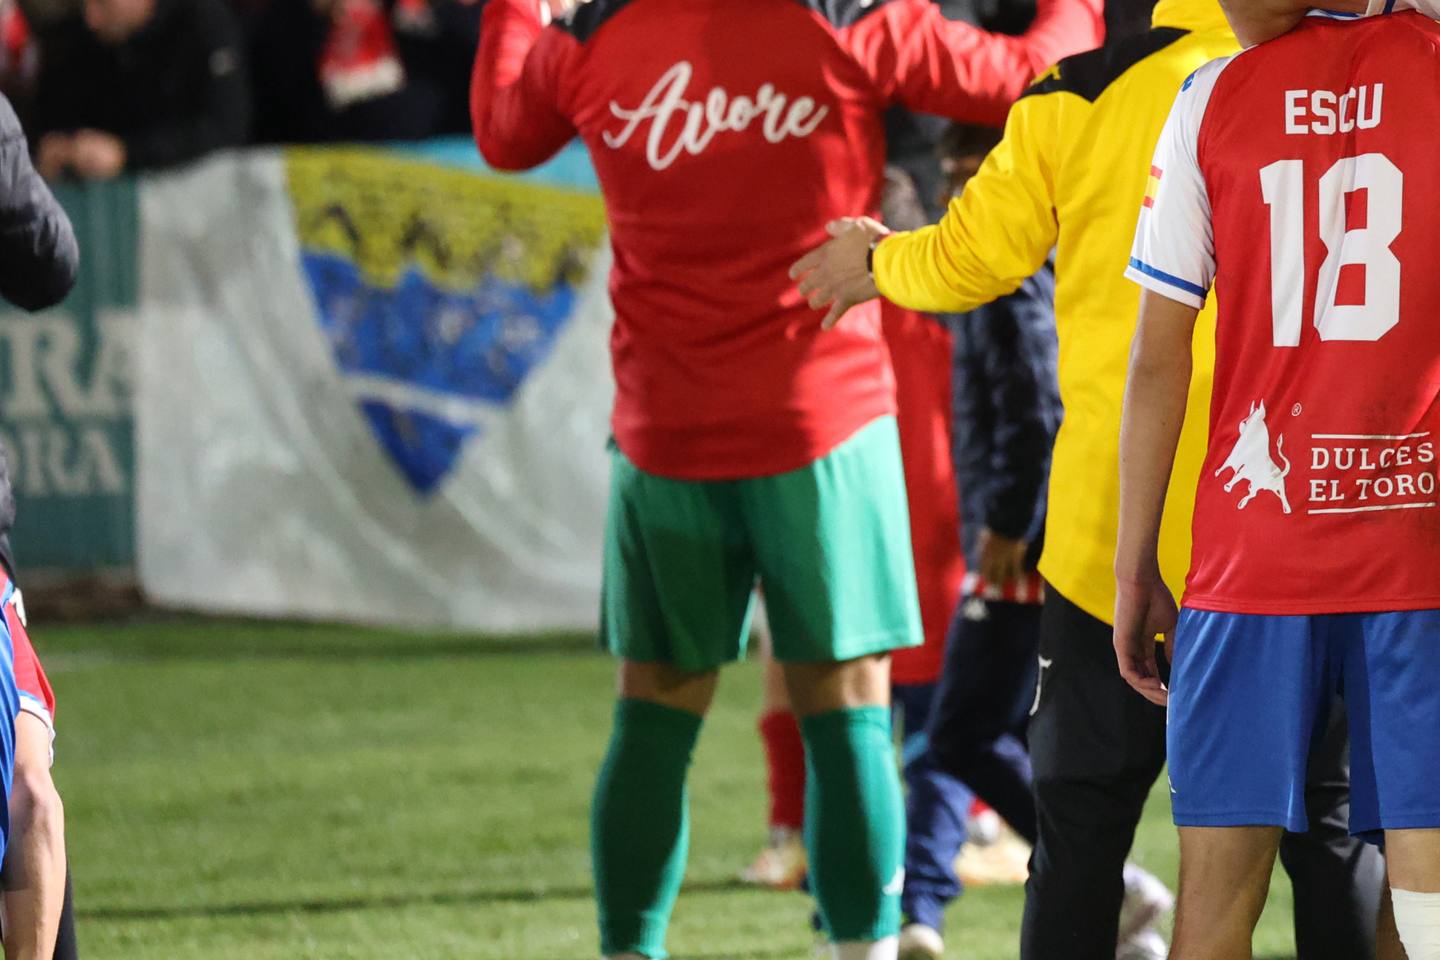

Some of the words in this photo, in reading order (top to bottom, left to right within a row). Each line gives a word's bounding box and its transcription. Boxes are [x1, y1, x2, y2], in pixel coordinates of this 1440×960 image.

[602, 60, 829, 171] Avore
[1285, 84, 1384, 135] ESCU
[1259, 152, 1403, 347] 18
[1311, 442, 1435, 471] DULCES
[1309, 480, 1345, 502] EL
[1356, 472, 1435, 500] TORO
